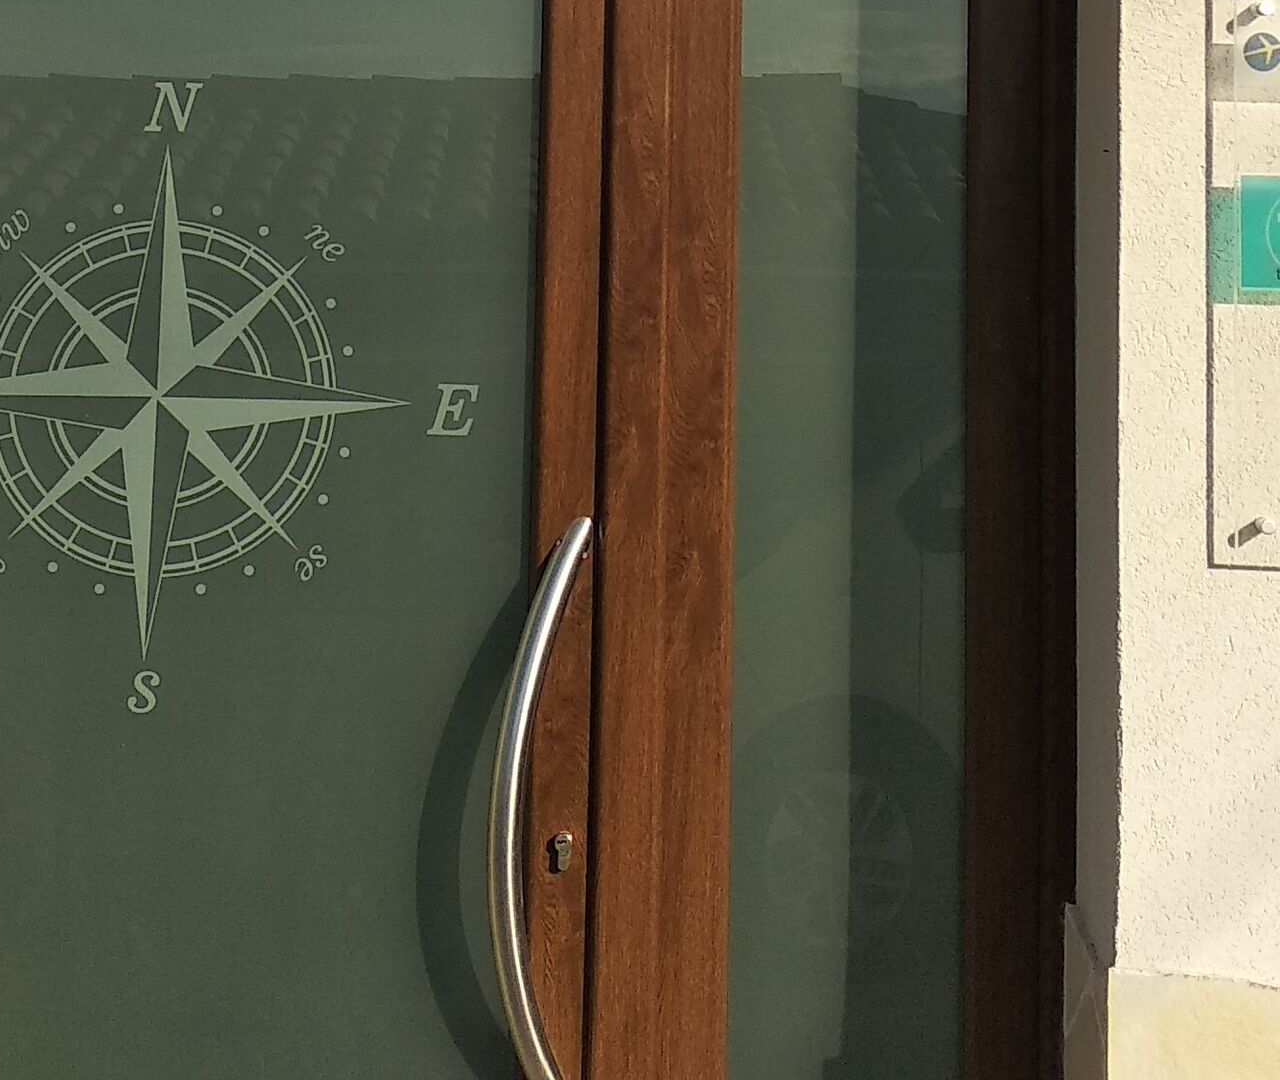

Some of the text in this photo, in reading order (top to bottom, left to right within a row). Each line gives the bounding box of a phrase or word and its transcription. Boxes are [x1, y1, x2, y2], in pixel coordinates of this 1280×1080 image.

[144, 81, 203, 133] N
[304, 221, 346, 262] ne
[426, 383, 480, 437] E
[127, 670, 161, 714] S
